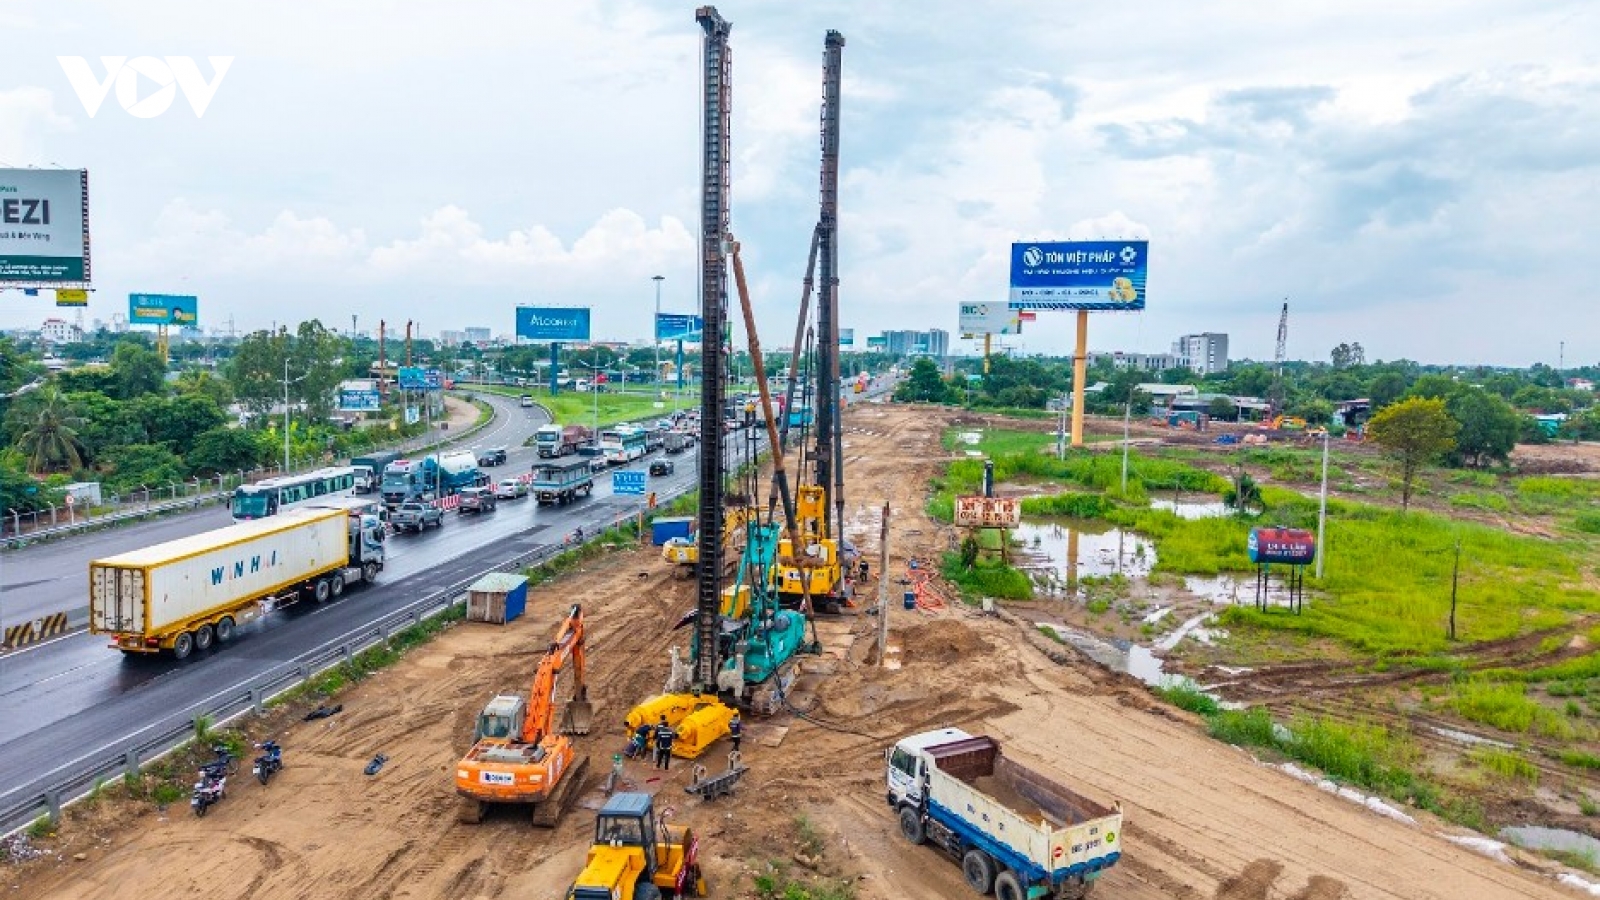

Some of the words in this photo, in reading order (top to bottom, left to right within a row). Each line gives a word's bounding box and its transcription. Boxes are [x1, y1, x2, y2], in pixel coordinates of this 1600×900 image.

[0, 198, 49, 225] EZI
[1045, 250, 1065, 263] TÔN
[1066, 250, 1087, 266] VIỆT
[1090, 249, 1116, 263] PHÁP
